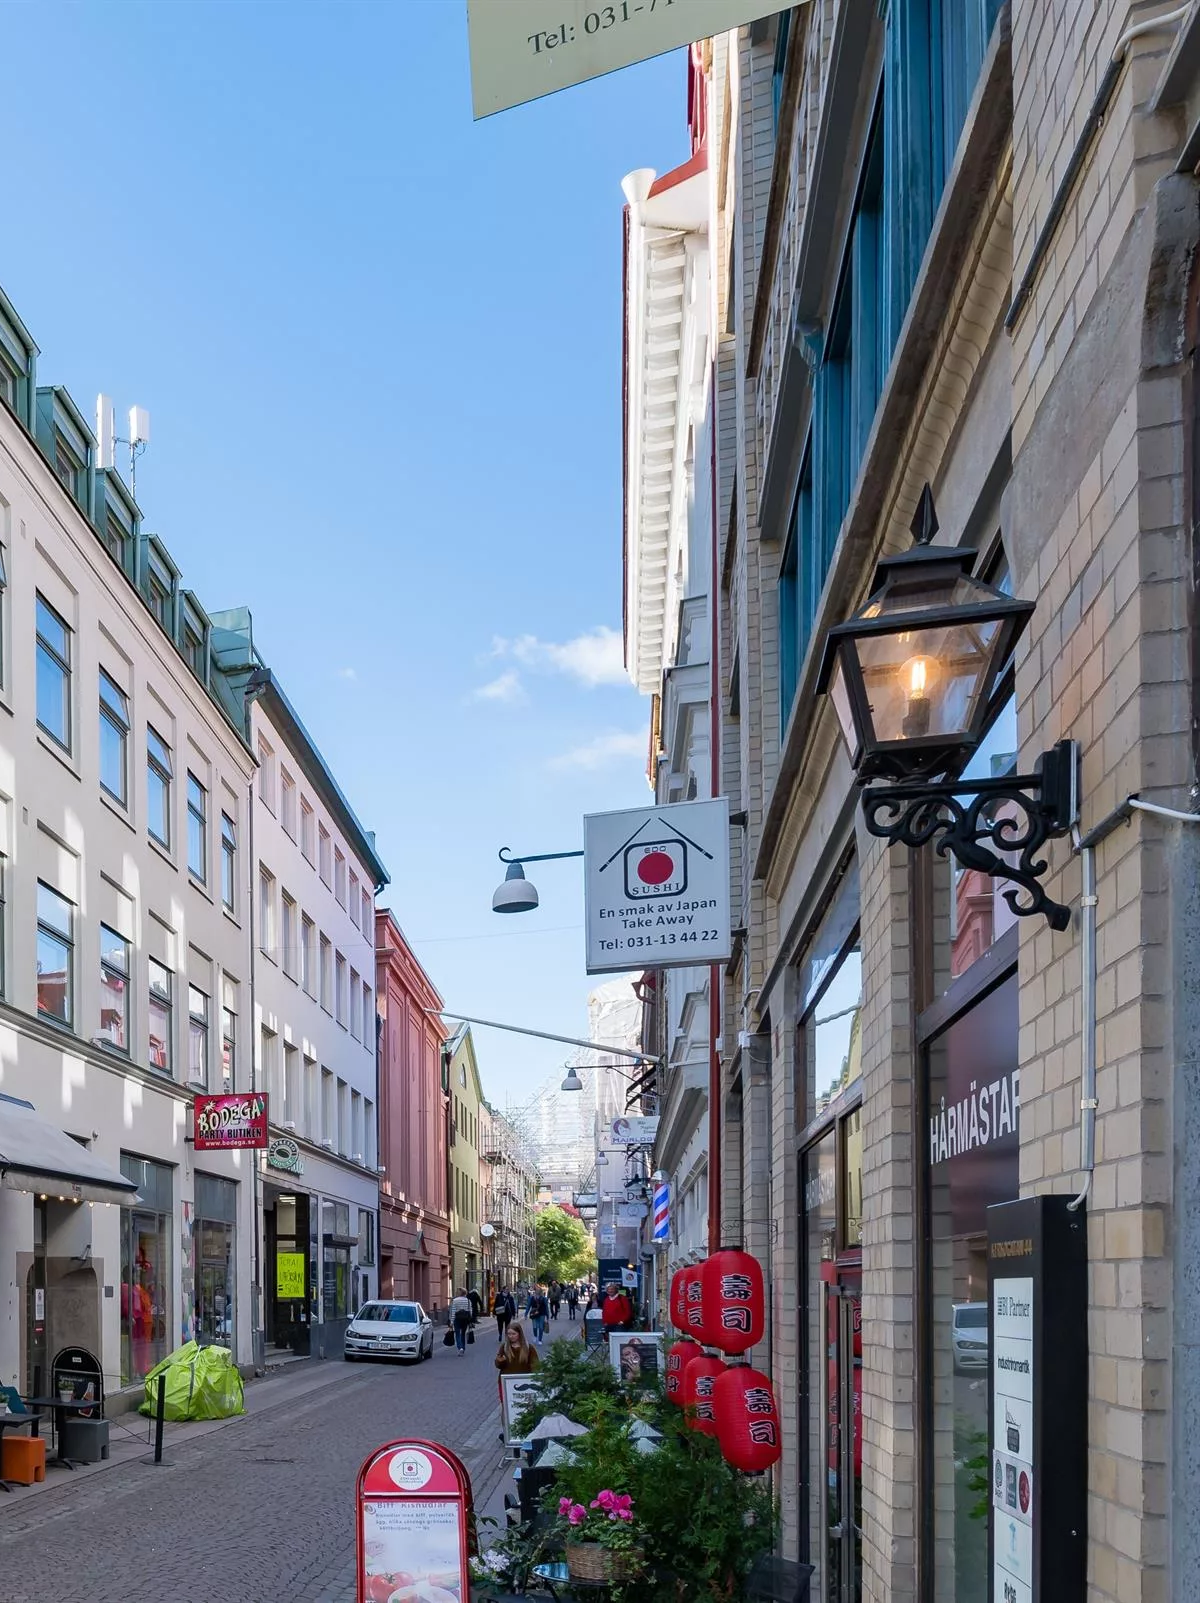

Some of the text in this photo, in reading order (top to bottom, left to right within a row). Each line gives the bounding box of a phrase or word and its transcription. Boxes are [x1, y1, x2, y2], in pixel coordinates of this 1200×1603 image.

[527, 24, 575, 55] Tel:
[643, 845, 667, 853] EDO
[632, 882, 681, 895] SUSHI
[599, 899, 717, 919] En smak av Japan
[622, 914, 694, 929] Take Away
[599, 929, 719, 950] Tel: 031-13 44 22
[198, 1097, 262, 1132] BODEGA
[200, 1128, 262, 1139] PARTY BUTIKEN
[205, 1139, 256, 1147] www.bodega.se
[270, 1139, 296, 1152] ESPRESSO
